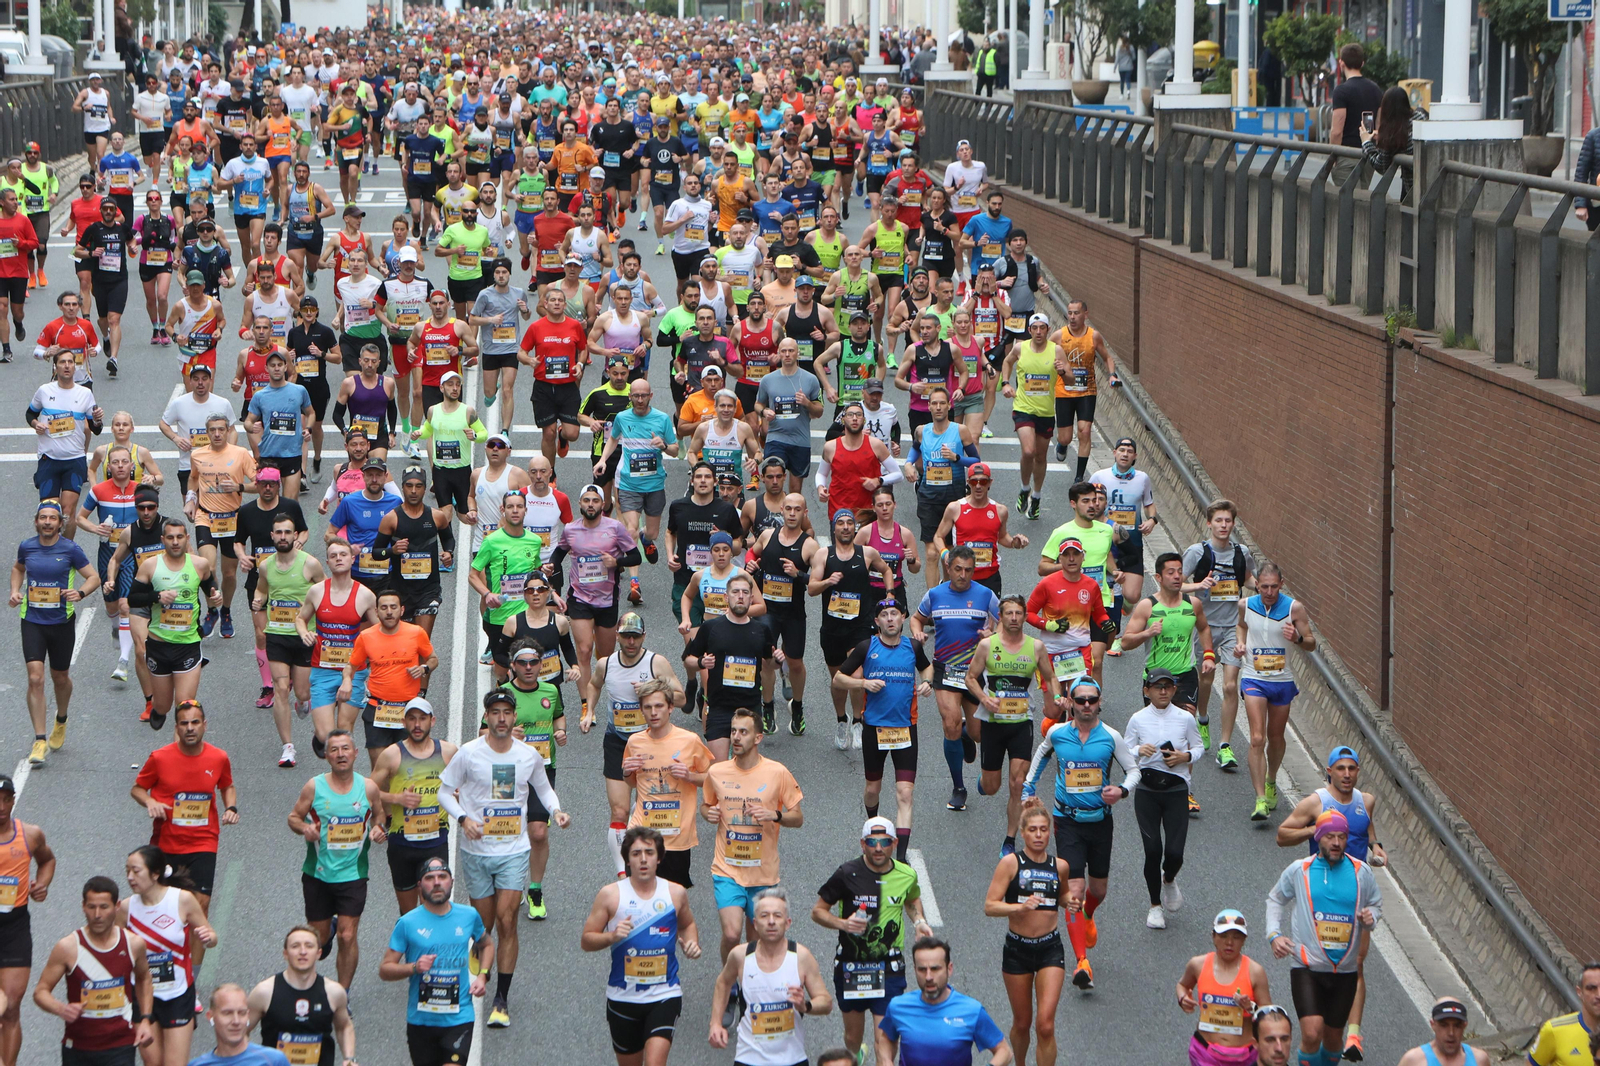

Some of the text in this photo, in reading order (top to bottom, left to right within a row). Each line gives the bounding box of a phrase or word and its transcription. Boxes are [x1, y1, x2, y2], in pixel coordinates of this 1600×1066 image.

[994, 660, 1027, 671] melgar
[340, 816, 361, 824] ZURICH
[1031, 870, 1053, 878] ZURICH
[1325, 914, 1349, 922] ZURICH
[639, 948, 662, 956] ZURICH
[857, 962, 881, 970] ZURICH
[95, 980, 120, 989] ZURICH
[763, 1003, 788, 1011] ZURICH
